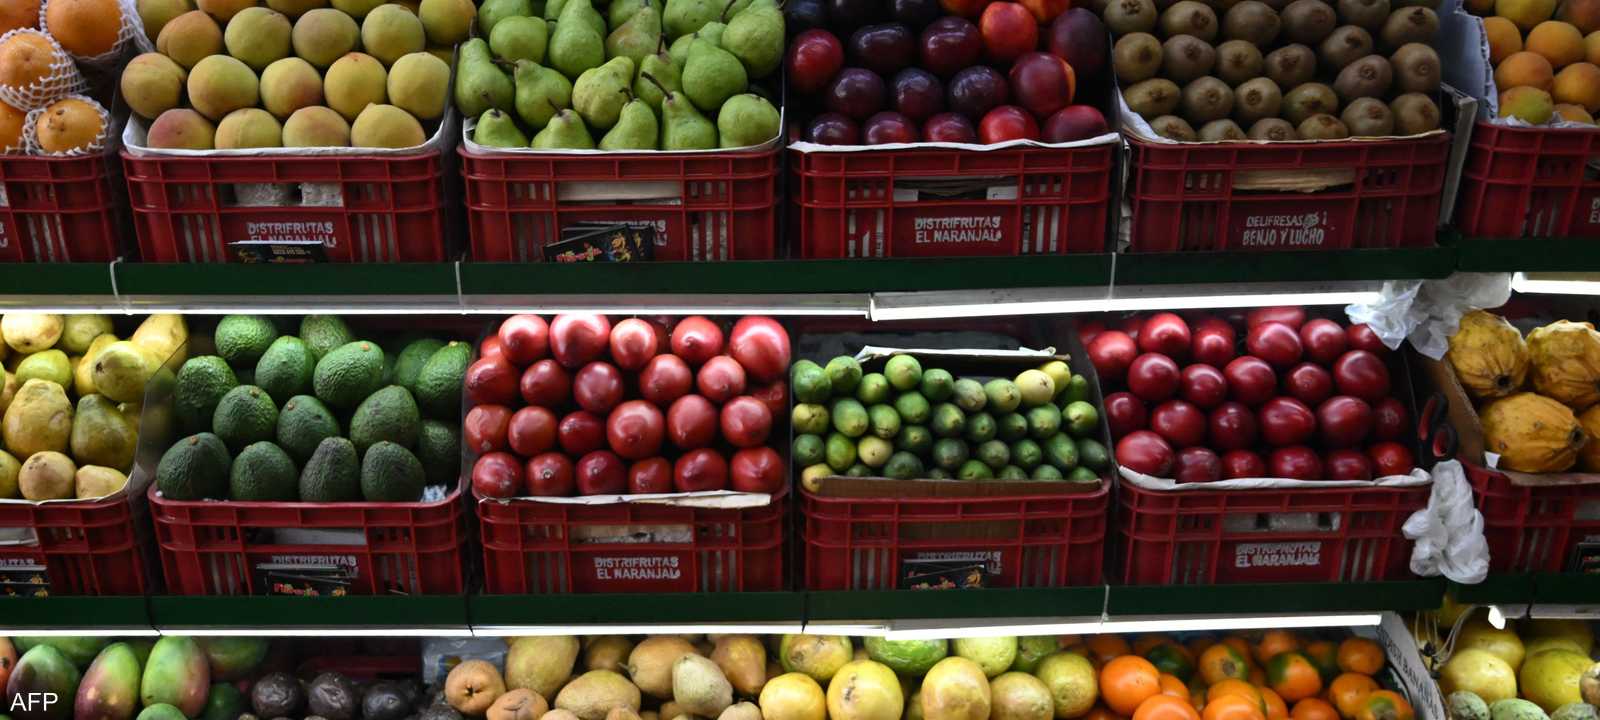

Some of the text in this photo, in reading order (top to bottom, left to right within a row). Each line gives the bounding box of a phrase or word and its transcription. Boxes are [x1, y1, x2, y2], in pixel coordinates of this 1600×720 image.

[915, 216, 1001, 230] DISTRIFRUTAS
[1246, 215, 1303, 227] DELIFRESAS
[247, 222, 334, 234] DISTRIFRUTAS
[916, 230, 929, 243] EL
[1243, 227, 1324, 246] BENJO Y LUCHO
[594, 556, 679, 568] DISTRIFRUTAS
[1235, 554, 1251, 567] EL
[597, 568, 611, 580] EL
